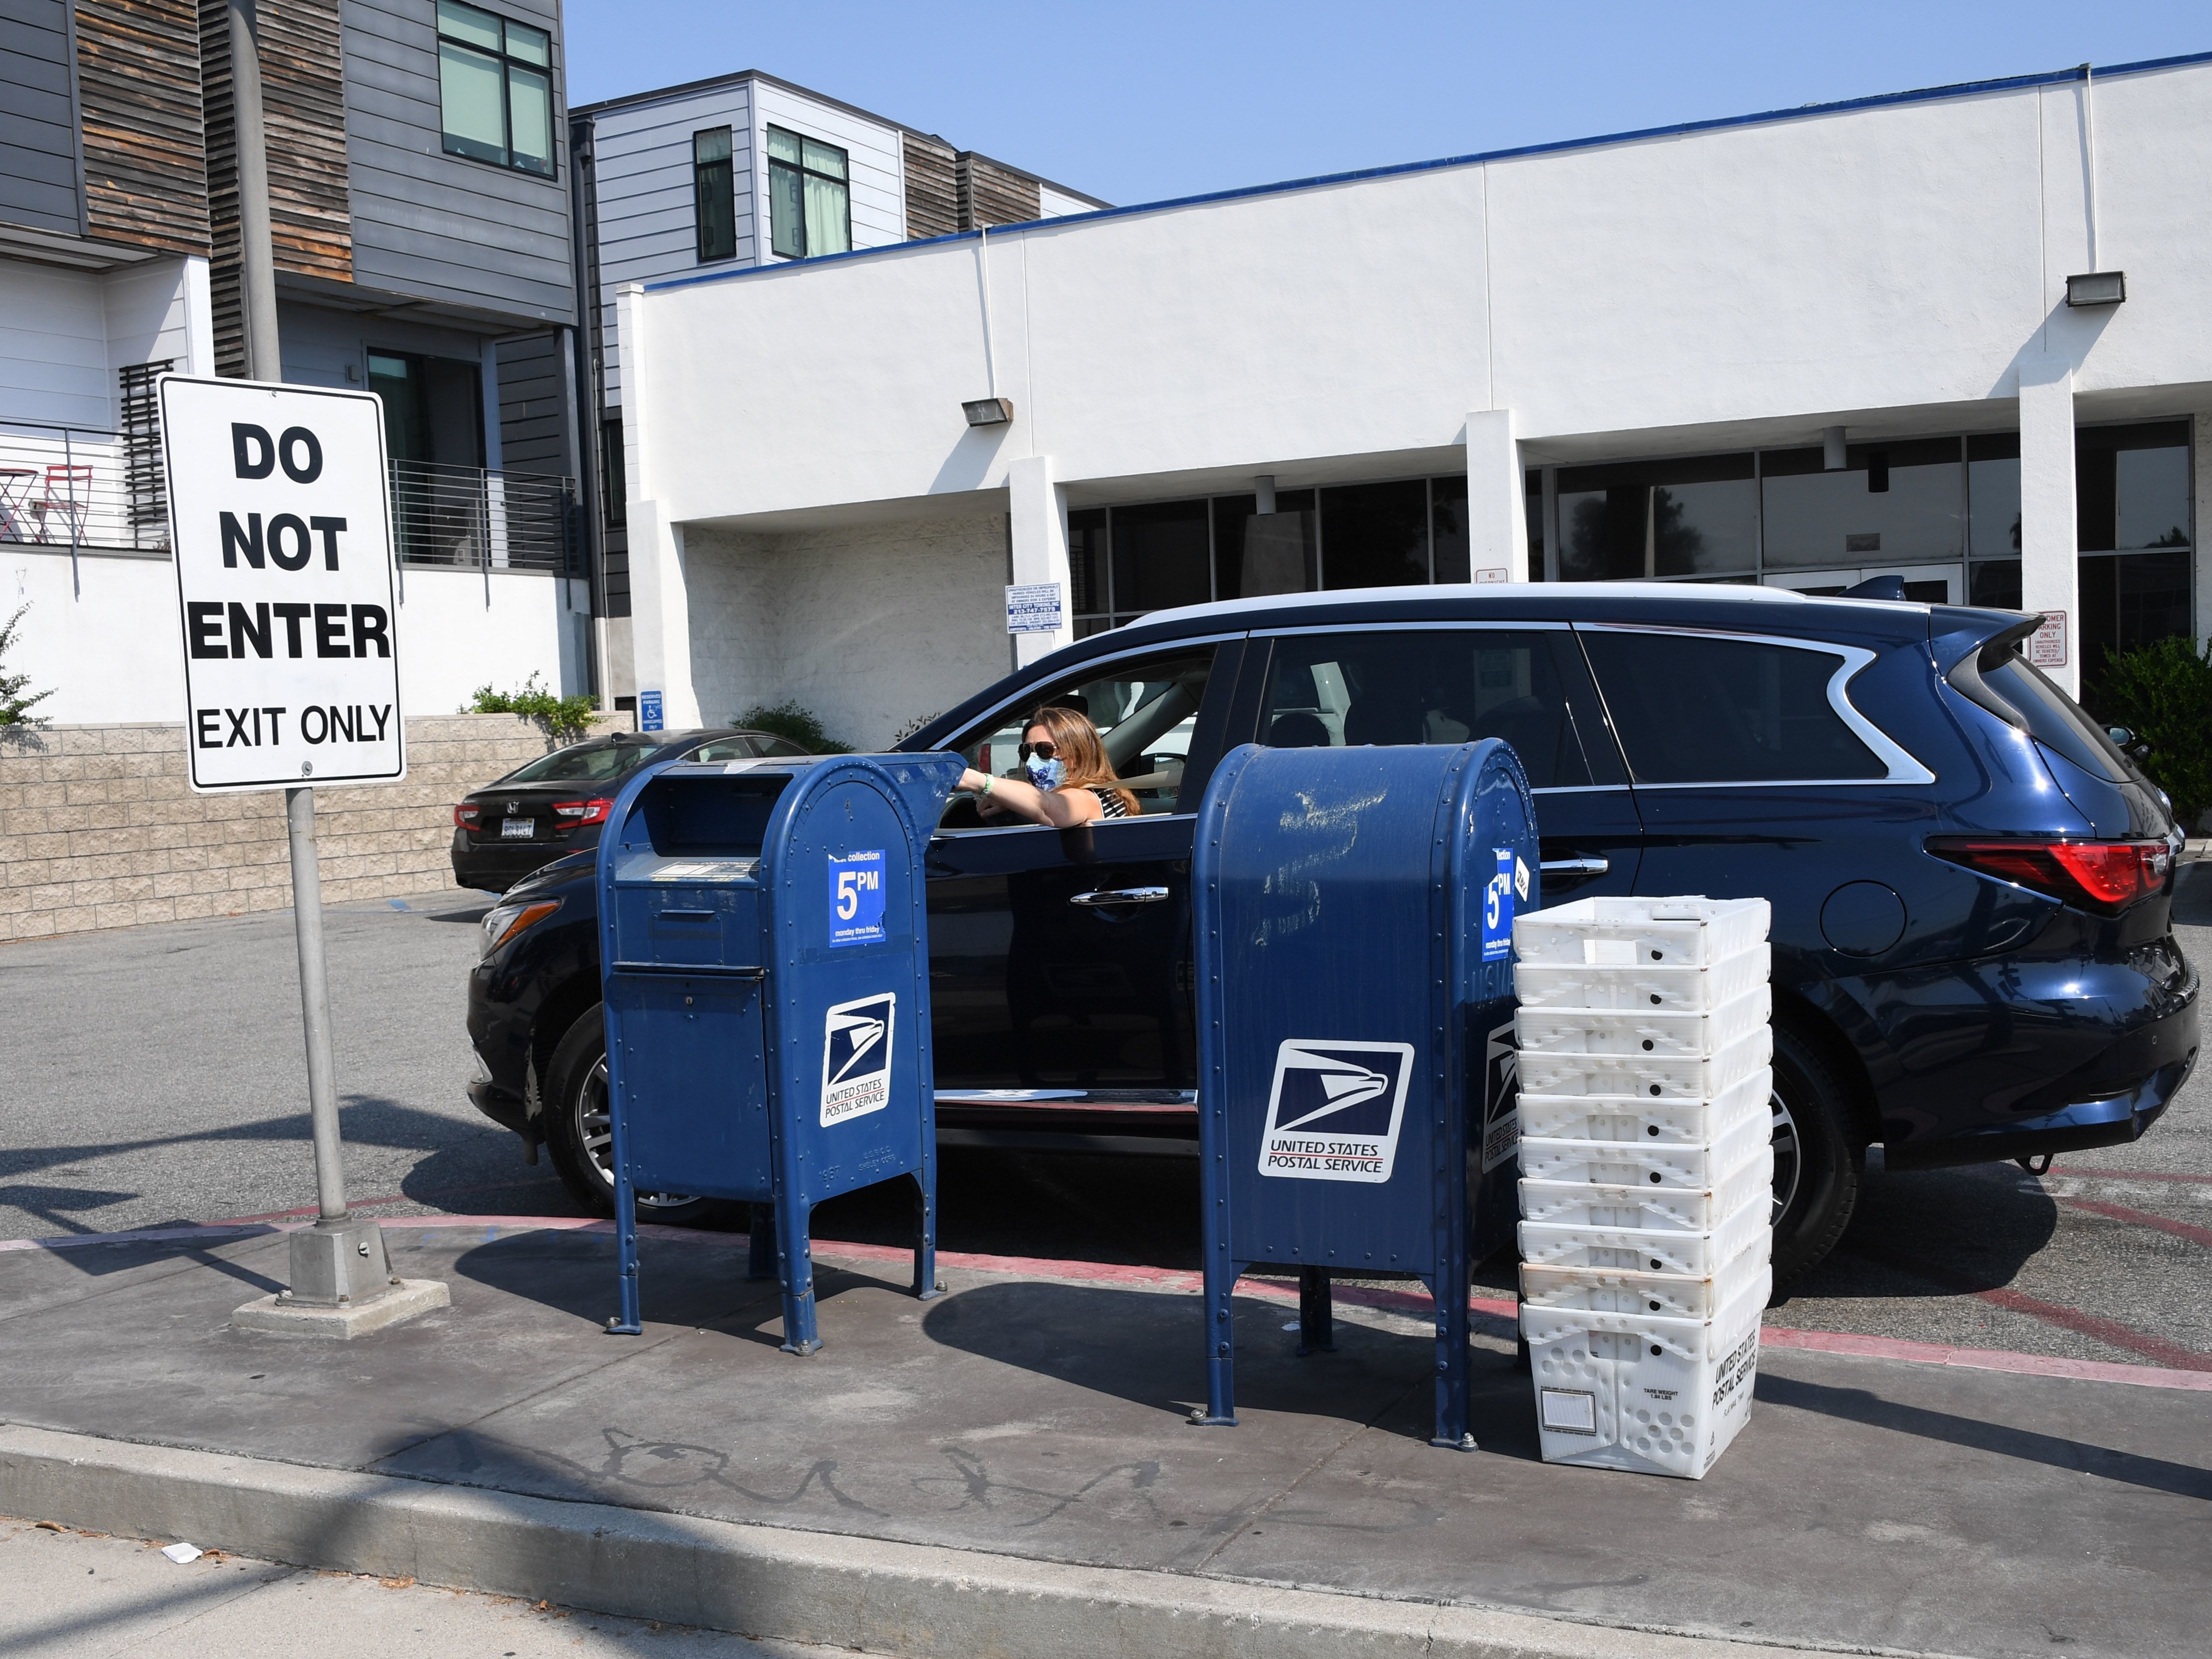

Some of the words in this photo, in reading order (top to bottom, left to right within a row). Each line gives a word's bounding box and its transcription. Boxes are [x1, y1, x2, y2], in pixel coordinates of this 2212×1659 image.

[231, 422, 323, 484] DO
[219, 511, 347, 571] NOT
[187, 601, 392, 658] ENTER
[197, 707, 286, 748] EXIT
[301, 705, 392, 744] ONLY
[848, 851, 880, 862] collection
[835, 928, 854, 937] monday
[866, 925, 880, 934] friday
[825, 1101, 853, 1119] POSTAL
[854, 1091, 885, 1109] SERVICE
[826, 1087, 854, 1104] UNITED
[855, 1078, 882, 1095] STATES
[1486, 1127, 1502, 1147] UNITED
[1502, 1117, 1517, 1137] STATES
[1270, 1140, 1325, 1154] UNITED
[1327, 1143, 1379, 1157] STATES
[1485, 1142, 1501, 1164] POSTAL
[1502, 1132, 1518, 1153] SERVICE
[1268, 1155, 1322, 1170] POSTAL
[1324, 1158, 1383, 1174] SERVICE
[1716, 1350, 1737, 1384] UNITED
[1737, 1331, 1755, 1363] STATES
[1712, 1373, 1734, 1411] POSTAL
[1735, 1350, 1756, 1386] SERVICE
